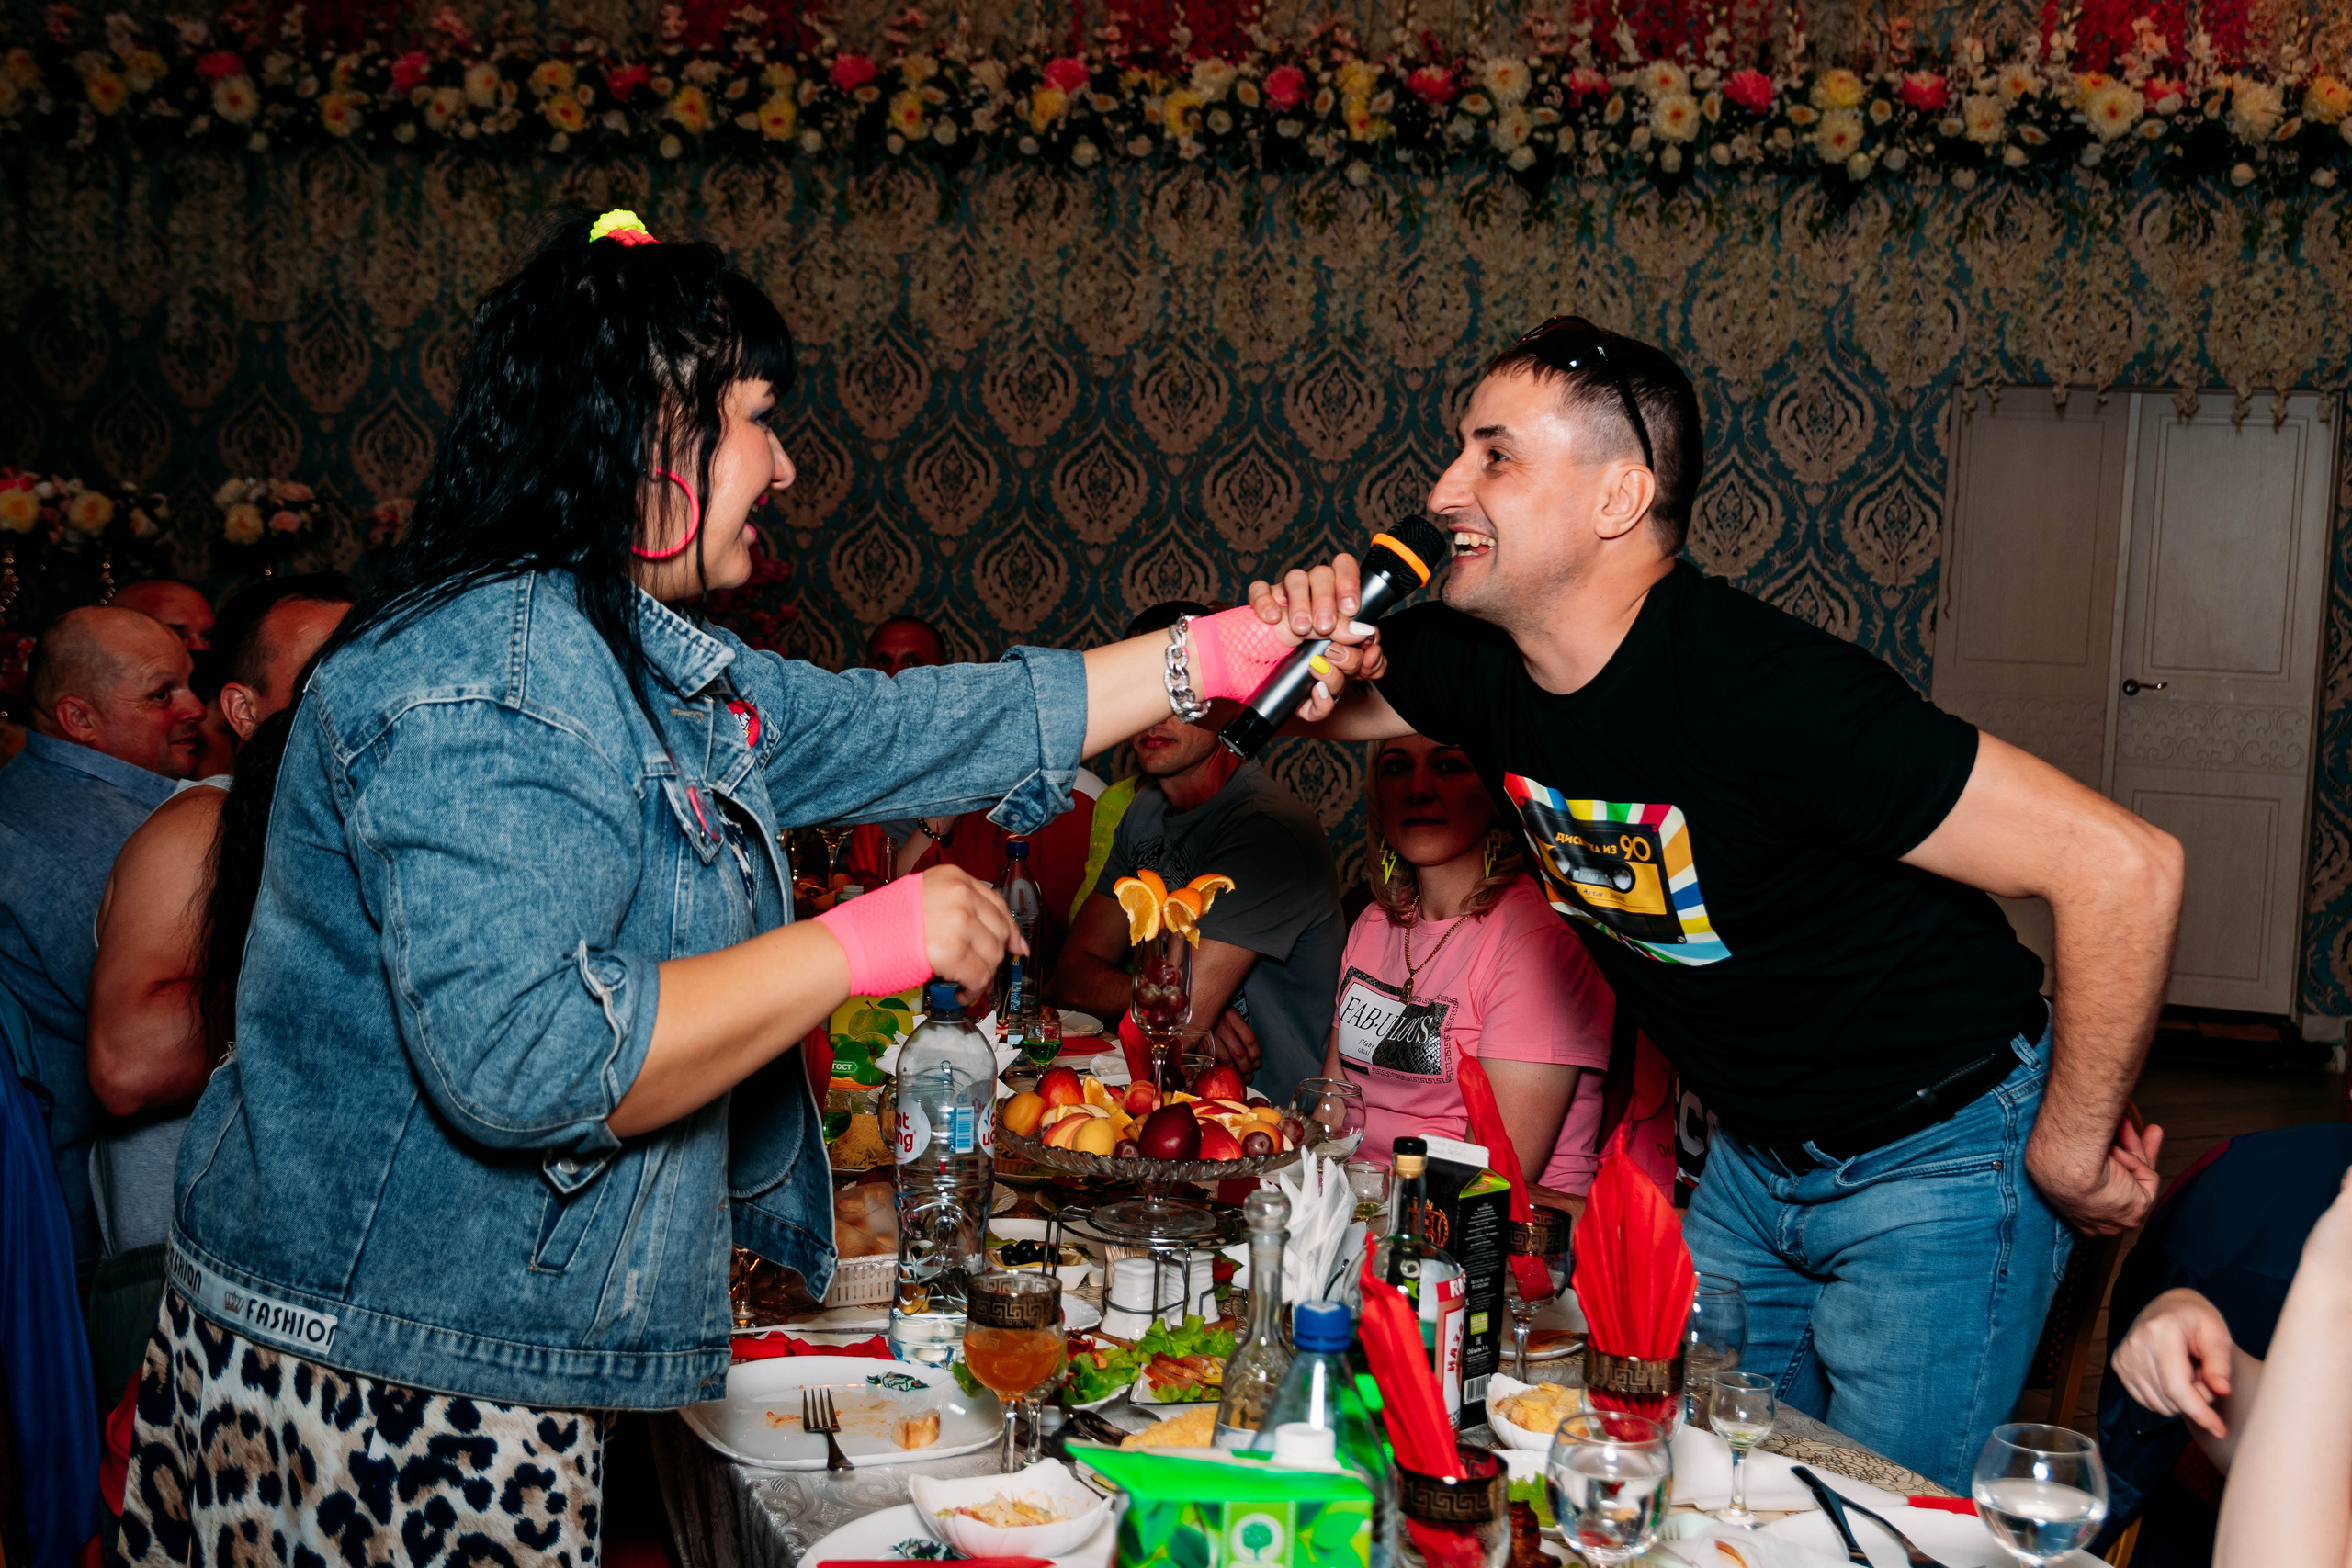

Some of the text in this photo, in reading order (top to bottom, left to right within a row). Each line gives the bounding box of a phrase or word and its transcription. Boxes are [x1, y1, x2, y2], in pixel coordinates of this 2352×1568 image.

[1602, 844, 1618, 855] ИЗ
[1619, 834, 1652, 862] 90
[831, 1063, 853, 1071] ГОСТ
[169, 1246, 202, 1294] ASHION
